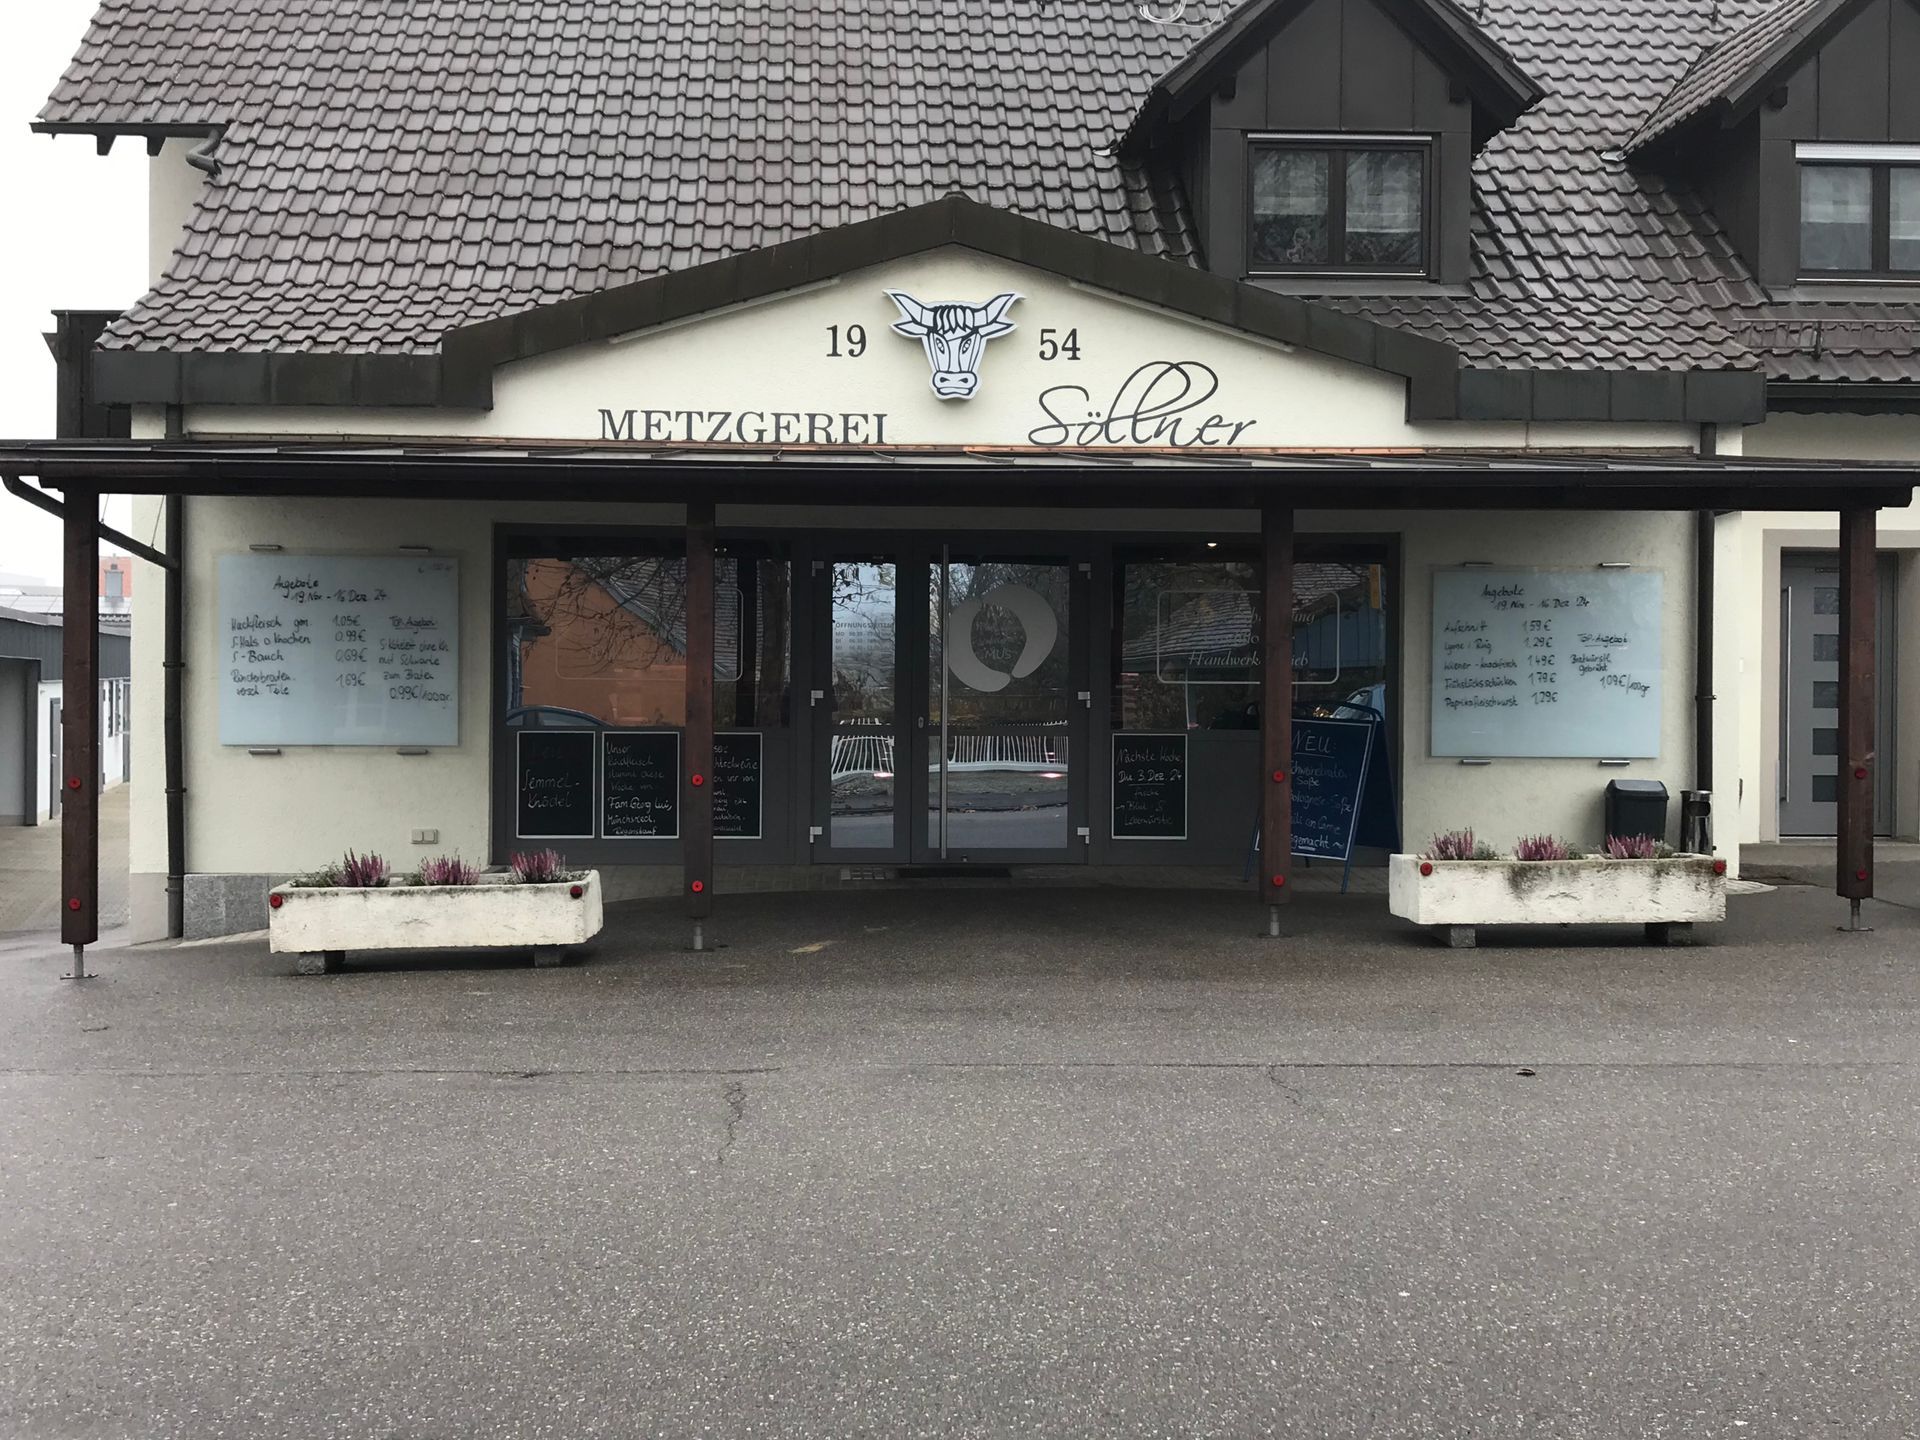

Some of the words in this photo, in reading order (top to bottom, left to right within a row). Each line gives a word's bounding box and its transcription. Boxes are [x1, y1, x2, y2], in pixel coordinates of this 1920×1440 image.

[825, 324, 867, 358] 19
[1037, 328, 1081, 362] 54
[1028, 361, 1257, 447] Söllner
[599, 409, 889, 444] METZGEREI
